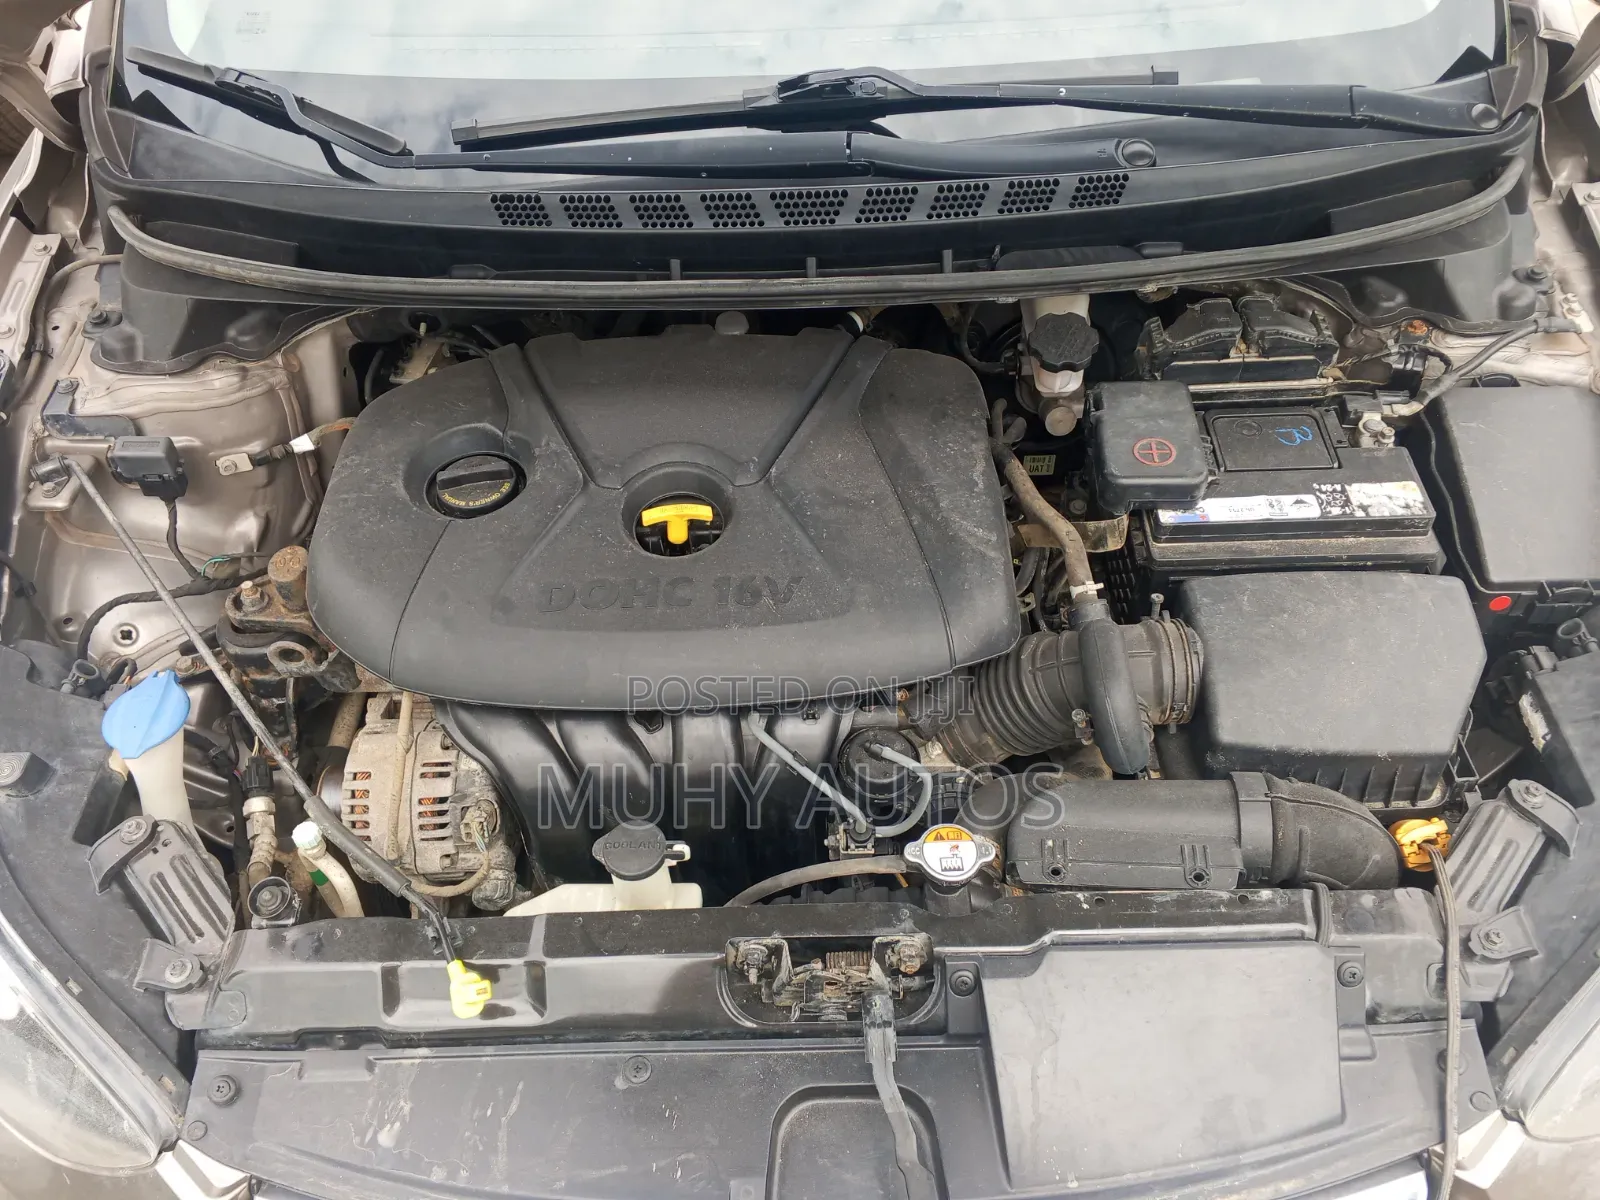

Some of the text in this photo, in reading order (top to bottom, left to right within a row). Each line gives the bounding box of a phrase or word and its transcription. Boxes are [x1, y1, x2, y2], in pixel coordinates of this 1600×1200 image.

[442, 481, 511, 507] SEE OWNER'S MANUAL
[538, 575, 805, 613] DOHC 16V
[604, 840, 662, 850] COOLANT
